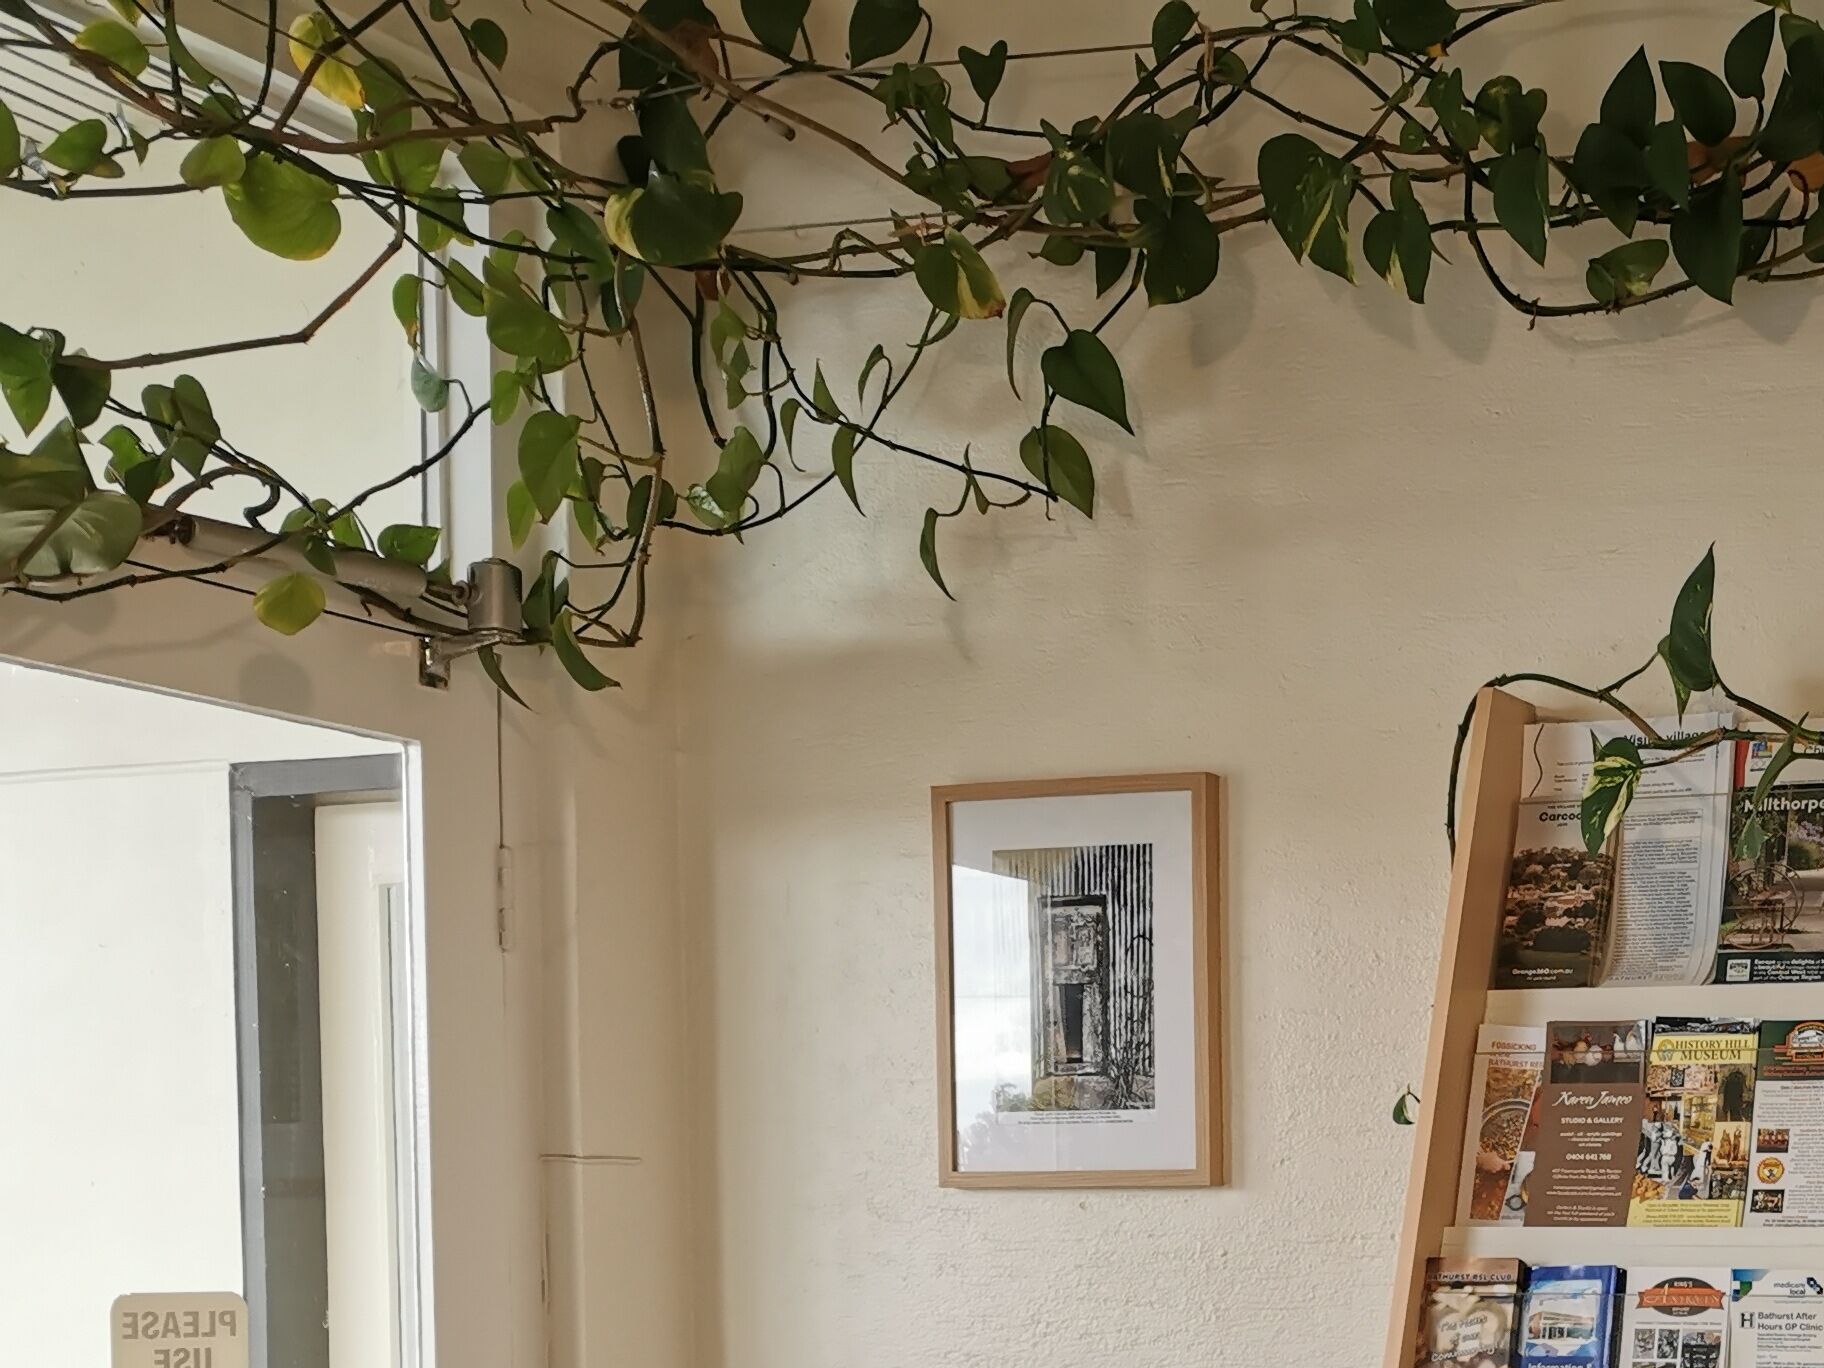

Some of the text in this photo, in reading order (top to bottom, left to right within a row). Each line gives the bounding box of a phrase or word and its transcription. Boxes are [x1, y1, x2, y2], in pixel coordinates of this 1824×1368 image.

[1675, 1039, 1751, 1049] HISTORY HILL
[1680, 1050, 1741, 1061] MUSEUM
[1593, 1116, 1624, 1124] GALLERY
[1789, 1288, 1806, 1296] local
[1757, 1312, 1817, 1321] Bathurst After
[1757, 1323, 1823, 1331] Hours GP Clinic
